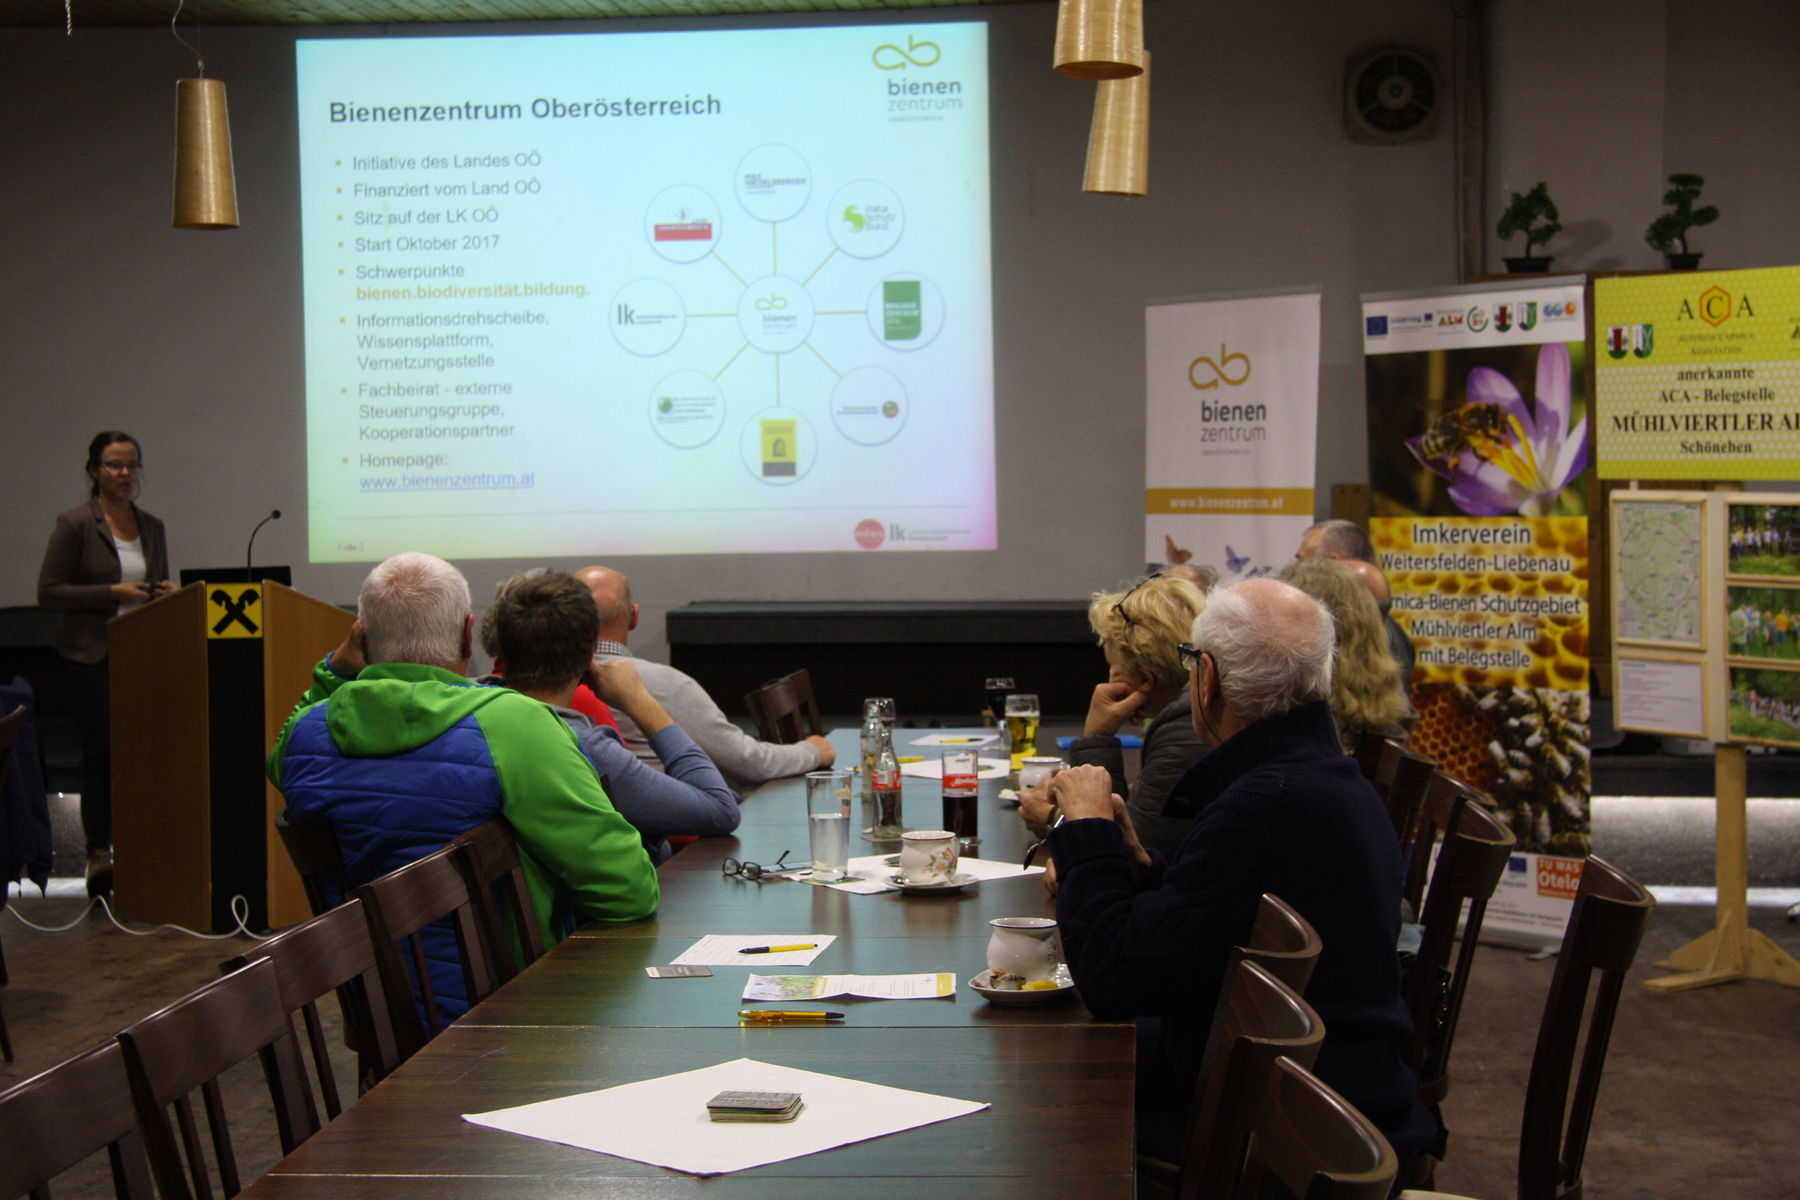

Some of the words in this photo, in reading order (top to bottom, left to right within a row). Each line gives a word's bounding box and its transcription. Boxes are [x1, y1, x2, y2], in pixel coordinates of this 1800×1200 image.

[887, 78, 961, 96] bienen
[329, 101, 522, 123] Bienenzentrum
[531, 93, 722, 118] Oberösterreich
[887, 98, 962, 112] zentrum
[352, 154, 415, 170] Initiative
[421, 153, 449, 169] des
[453, 152, 510, 168] Landes
[514, 149, 542, 167] OÖ
[353, 181, 430, 198] Finanziert
[434, 183, 466, 196] vom
[471, 179, 509, 195] Land
[514, 176, 542, 195] OÖ
[354, 210, 383, 226] Sitz
[388, 209, 412, 224] auf
[416, 208, 441, 224] der
[446, 207, 467, 223] LK
[472, 204, 500, 223] OÖ
[355, 236, 391, 252] Start
[396, 234, 458, 251] Oktober
[462, 234, 500, 249] 2017
[355, 264, 465, 281] Schwerpunkte
[356, 281, 590, 300] bienen.biodiversität.bildung.
[1677, 295, 1754, 320] ACA
[356, 309, 550, 329] Informationsdrehscheibe,
[357, 332, 494, 351] Wissensplattform,
[357, 354, 495, 373] Vernetzungsstelle
[1677, 368, 1754, 381] anerkannte
[358, 383, 440, 398] Fachbeirat
[455, 381, 512, 395] externe
[1660, 390, 1690, 403] ACA
[1704, 388, 1775, 404] Belegstelle
[359, 403, 505, 422] Steuerungsgruppe,
[1201, 401, 1266, 422] bienen
[1612, 411, 1773, 432] MÜHLVIERTLER
[359, 425, 514, 444] Kooperationspartner
[1200, 424, 1266, 443] zentrum
[1680, 440, 1752, 453] Schöneben
[359, 454, 448, 471] Homepage:
[359, 472, 535, 492] www.bienenzentrum.at
[1170, 496, 1283, 509] www.bienenzentrum.at
[1413, 523, 1531, 544] Imkerverein
[1380, 552, 1570, 572] Weitersfelden-Liebenau
[1480, 594, 1581, 616] Schutzgebiet
[1411, 619, 1501, 639] Mühlviertler
[1506, 623, 1537, 640] Alm
[1419, 649, 1443, 664] mit
[1449, 648, 1530, 670] Belegstelle
